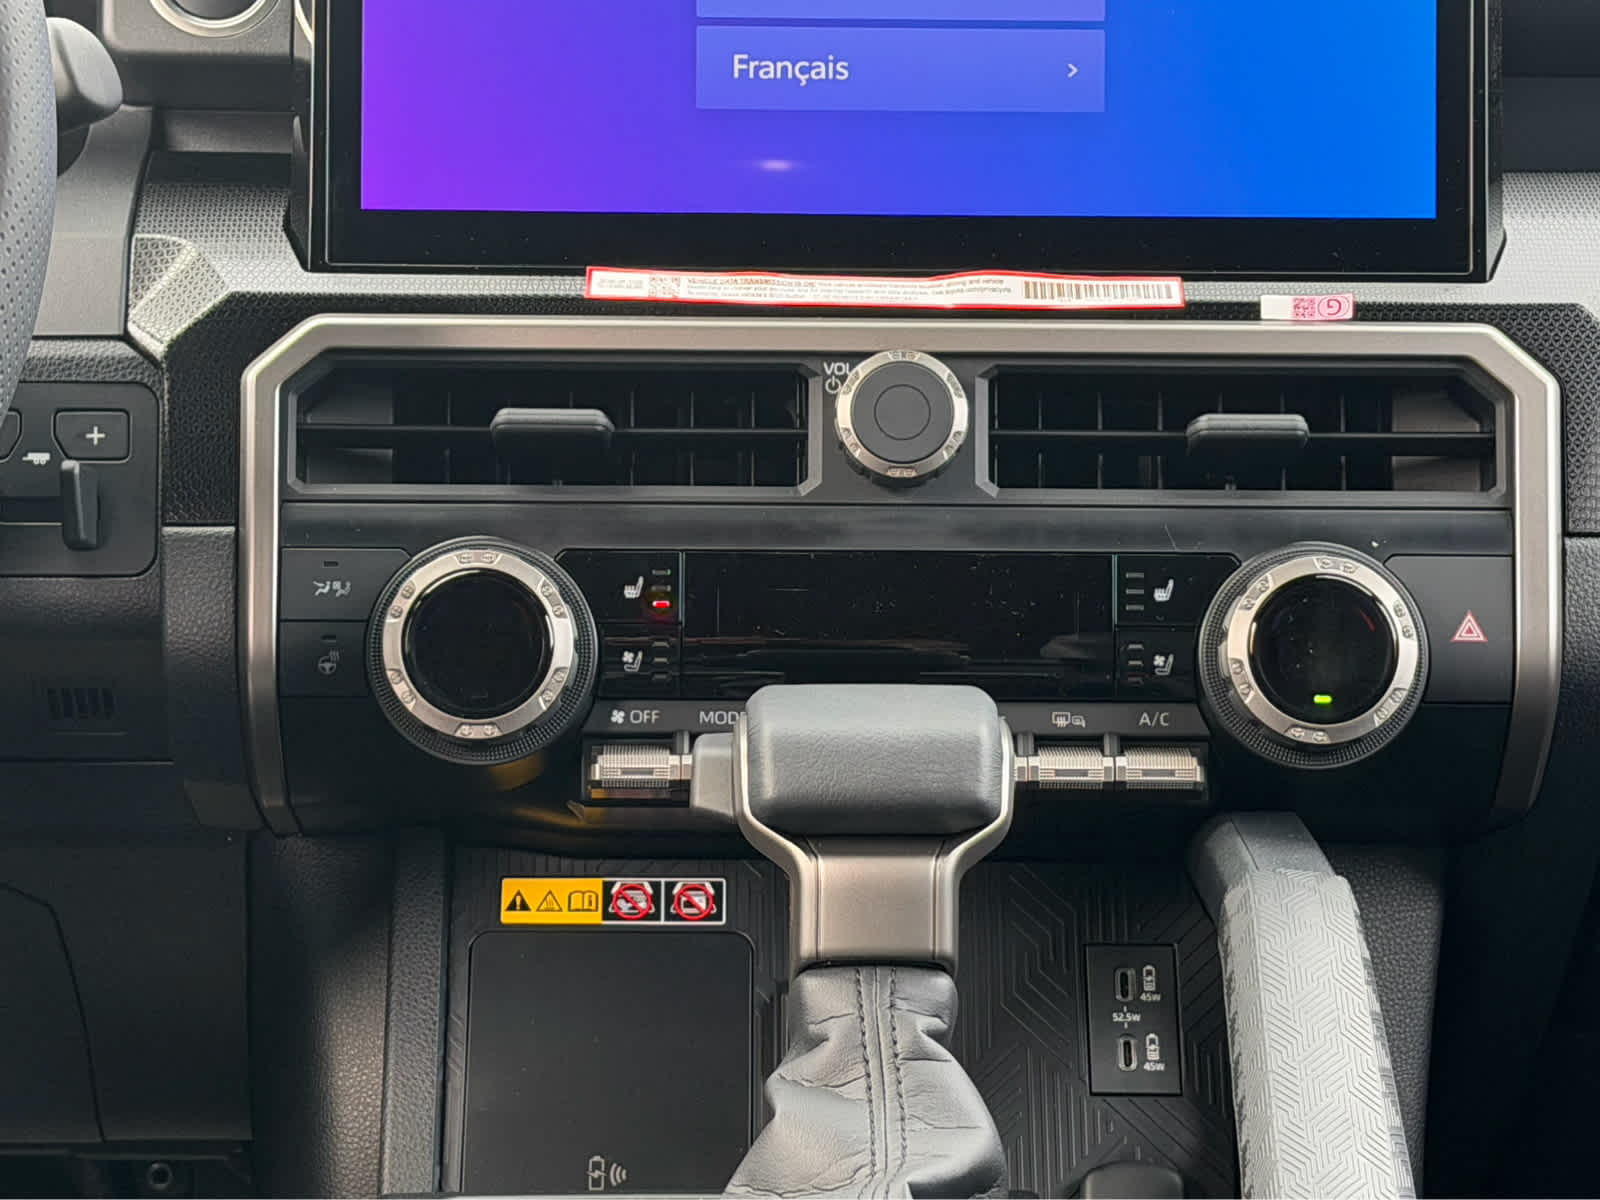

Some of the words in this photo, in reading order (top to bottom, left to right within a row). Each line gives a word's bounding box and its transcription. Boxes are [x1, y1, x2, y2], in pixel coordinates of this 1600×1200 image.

[733, 53, 849, 86] Français
[629, 709, 661, 724] OFF
[1138, 711, 1170, 727] A/C
[1139, 992, 1161, 1001] 45W
[1112, 1012, 1141, 1022] 52.5W
[1143, 1062, 1165, 1071] 45W
